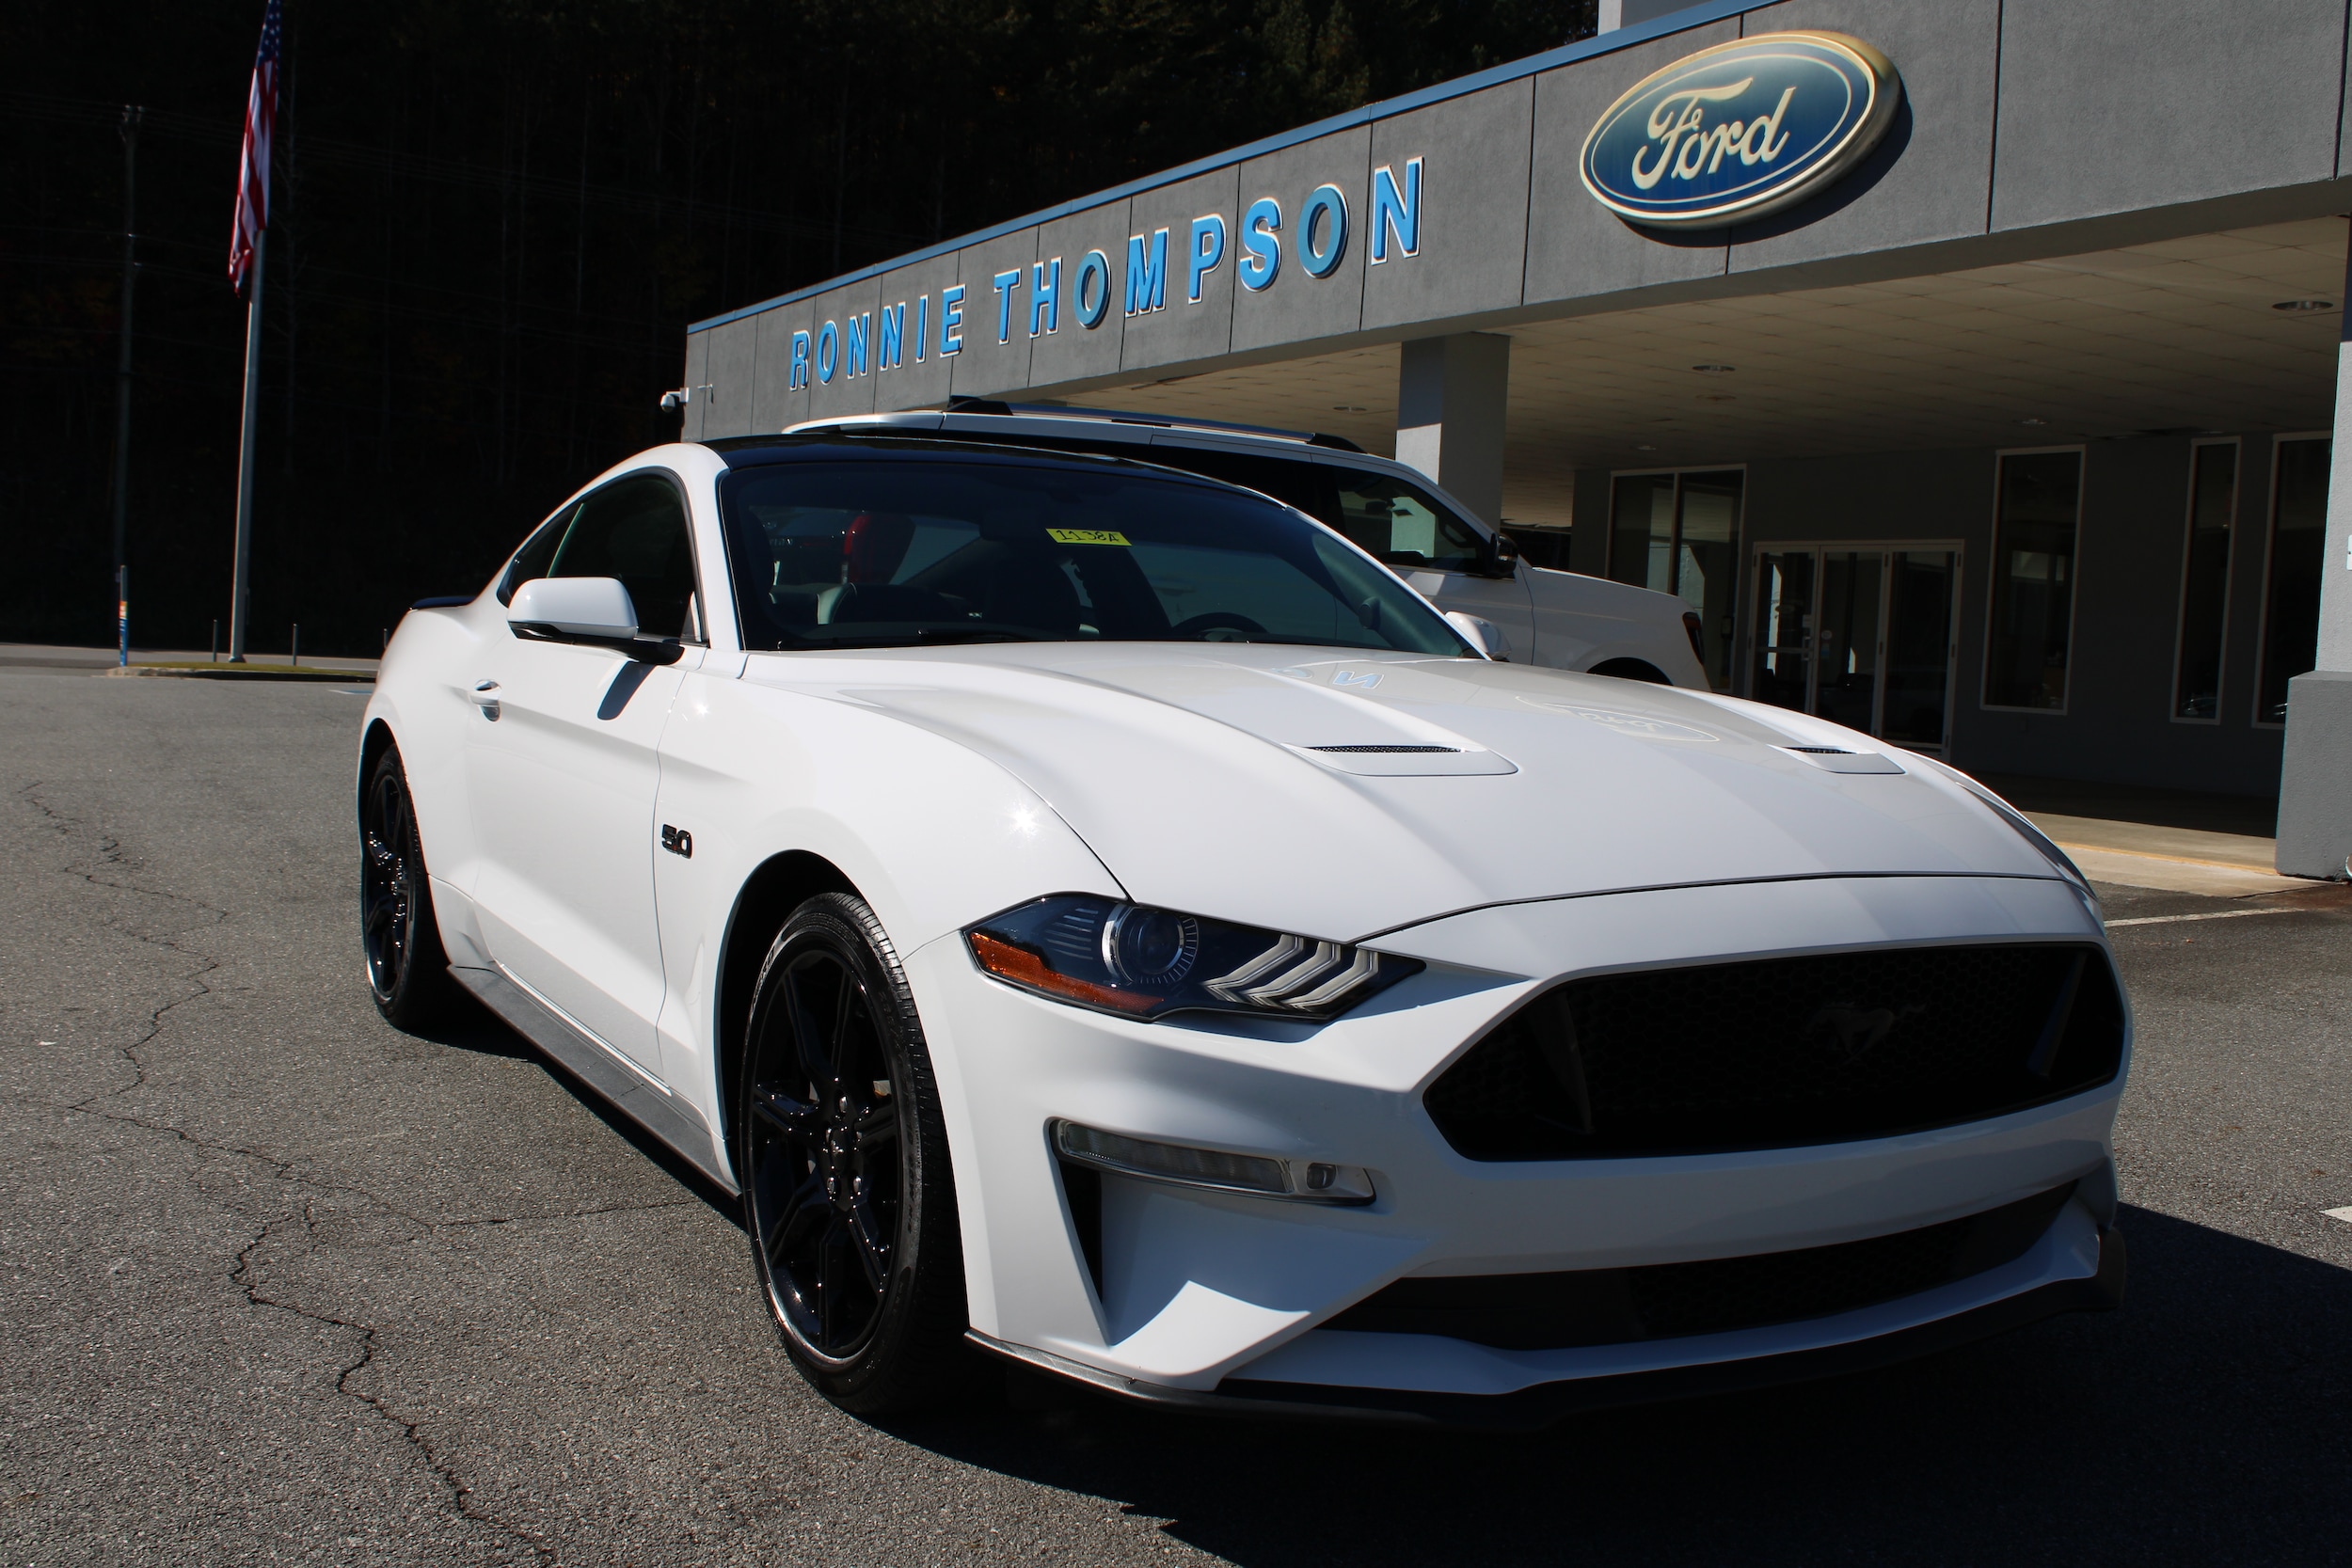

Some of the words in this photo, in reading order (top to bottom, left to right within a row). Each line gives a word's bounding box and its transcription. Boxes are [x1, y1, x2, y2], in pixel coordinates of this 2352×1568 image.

[1631, 77, 1796, 189] Ford
[788, 284, 967, 391] RONNIE
[993, 156, 1424, 346] THOMPSON
